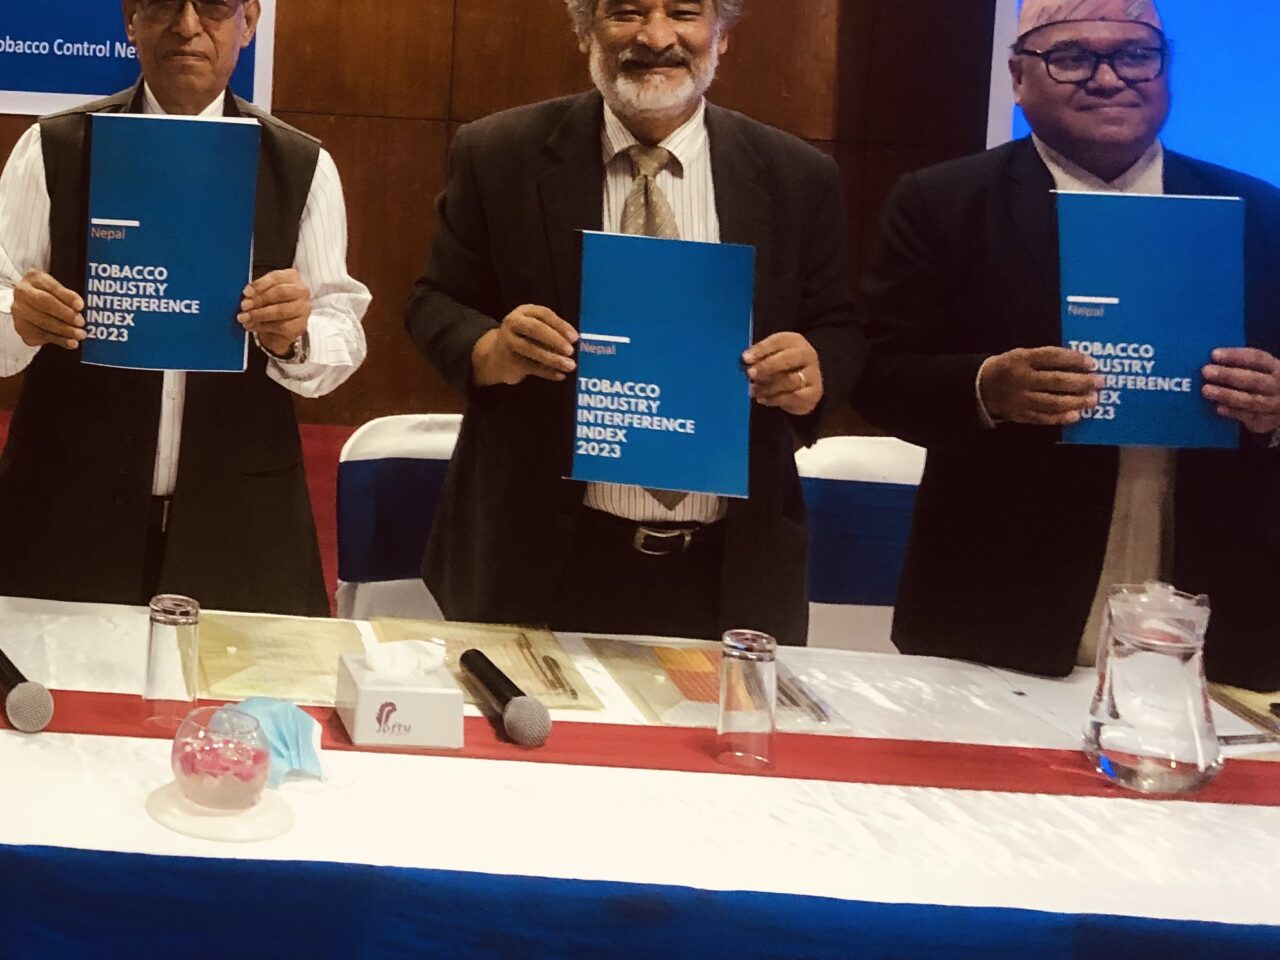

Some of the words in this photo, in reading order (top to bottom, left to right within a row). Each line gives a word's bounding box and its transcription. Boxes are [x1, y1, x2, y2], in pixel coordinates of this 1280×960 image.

[53, 39, 110, 57] Control
[114, 41, 140, 58] Ne
[91, 227, 125, 241] Nepal
[89, 262, 168, 280] TOBACCO
[88, 279, 168, 296] INDUSTRY
[87, 294, 200, 314] INTERFERENCE
[86, 310, 135, 326] INDEX
[86, 325, 129, 342] 2023
[580, 342, 616, 356] Nepal
[1068, 341, 1155, 358] TOBACCO
[1090, 358, 1155, 374] DUSTRY
[578, 377, 661, 398] TOBACCO
[578, 393, 661, 413] INDUSTRY
[1080, 405, 1116, 420] 023
[577, 409, 696, 434] INTERFERENCE
[576, 424, 628, 442] INDEX
[576, 441, 622, 458] 2023
